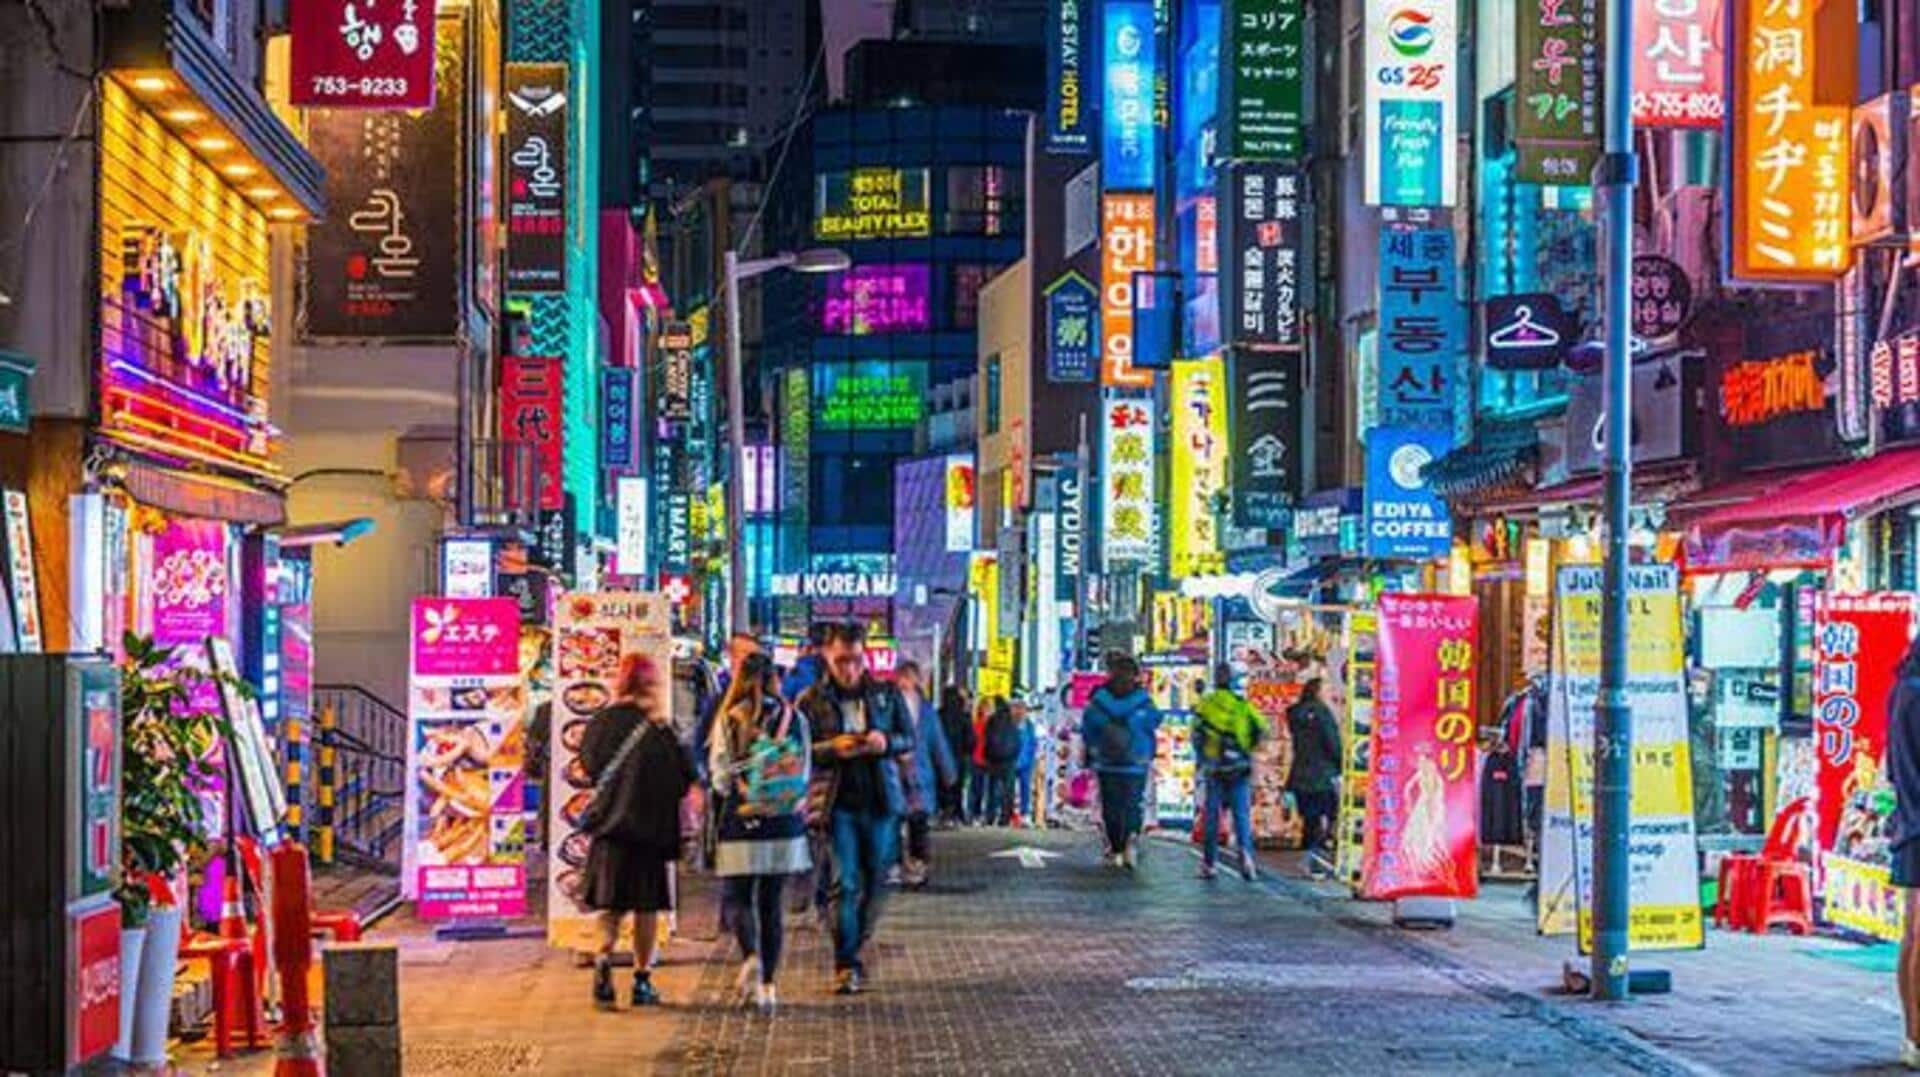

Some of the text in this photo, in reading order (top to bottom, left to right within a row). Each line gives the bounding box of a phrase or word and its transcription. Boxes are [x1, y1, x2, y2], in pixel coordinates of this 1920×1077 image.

[1241, 13, 1296, 30] コリア
[1061, 25, 1078, 71] STAY
[1061, 74, 1078, 131] HOTEL
[851, 196, 900, 211] TOTAL
[821, 212, 929, 233] BEAUTY PLEX
[1386, 268, 1447, 403] 부동산
[1372, 502, 1432, 518] EDIYA
[1371, 521, 1449, 537] COFFEE
[803, 572, 868, 596] KOREA
[442, 623, 500, 643] エステ
[1820, 622, 1859, 764] 韓国のり
[1436, 638, 1473, 781] 韓国のり
